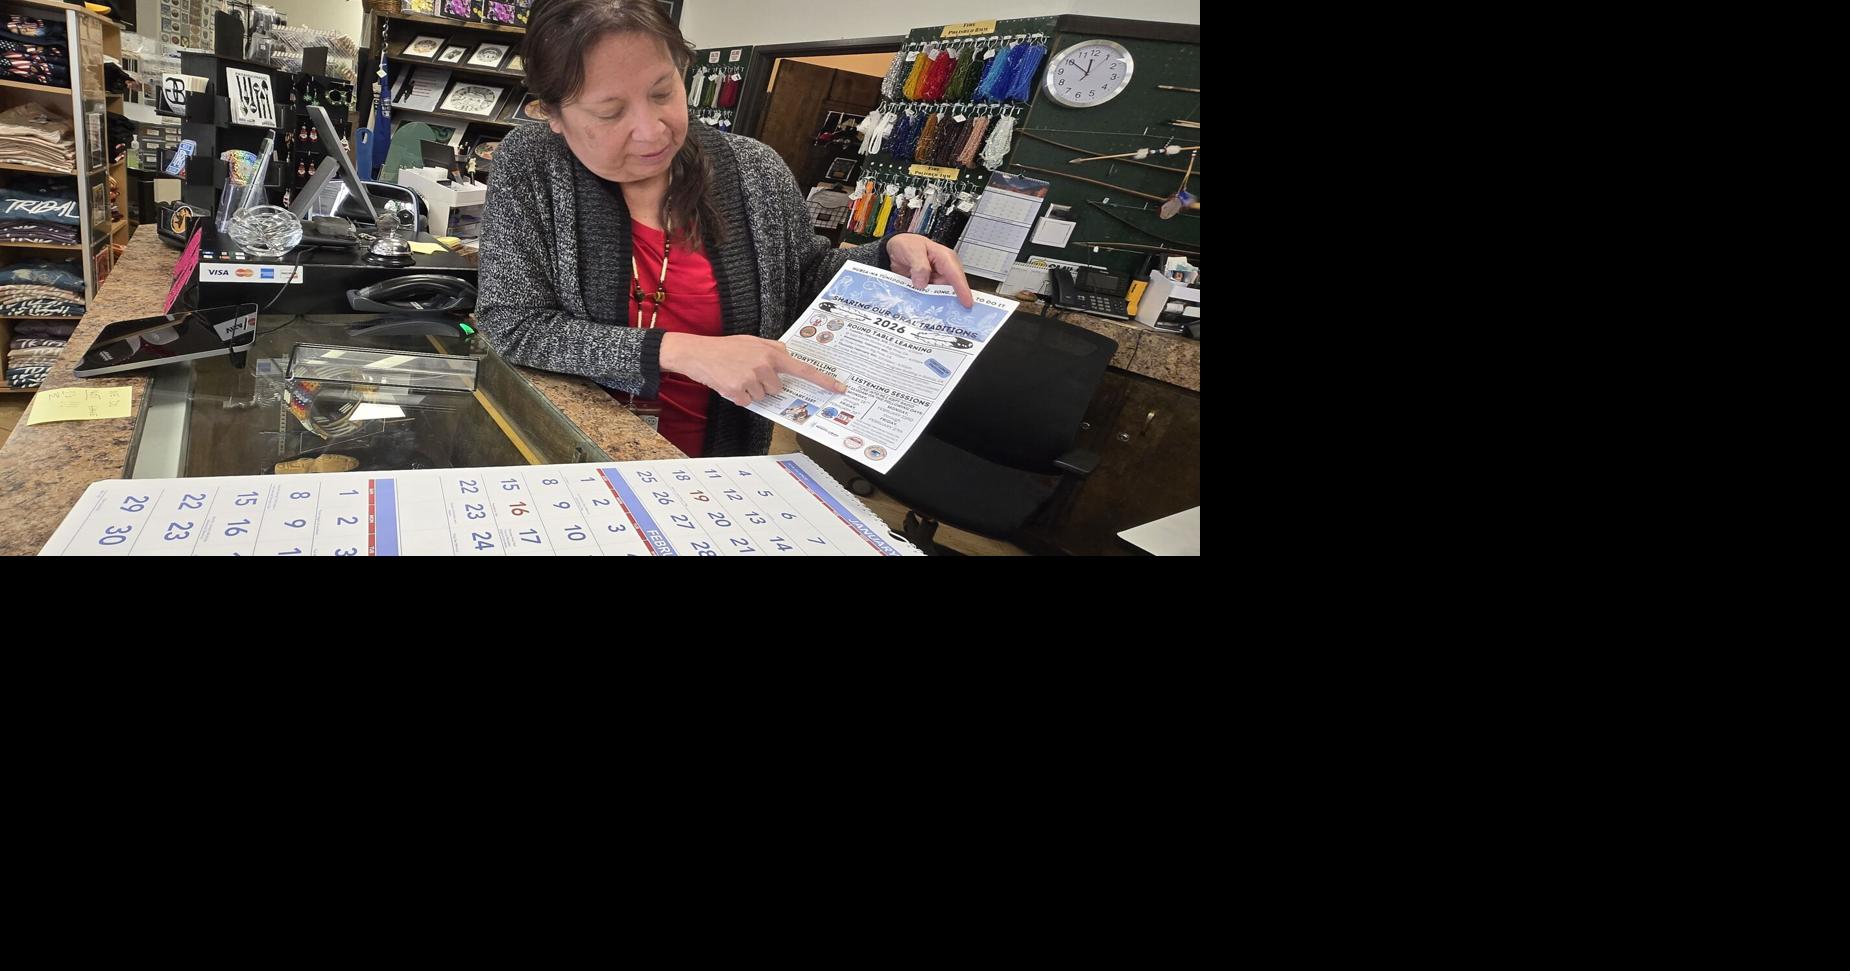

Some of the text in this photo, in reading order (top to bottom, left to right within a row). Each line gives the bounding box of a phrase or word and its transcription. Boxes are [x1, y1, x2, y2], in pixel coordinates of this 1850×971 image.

[5, 198, 80, 218] TRIBAL
[832, 295, 978, 339] SHARING OUR ORAL TRADITIONS
[873, 318, 906, 334] 2026
[847, 322, 932, 354] ROUND TABLE LEARNING
[851, 375, 891, 394] LISTENING
[891, 390, 931, 408] SESSIONS
[120, 495, 149, 513] 29
[164, 493, 207, 541] 22 23
[224, 491, 259, 537] 15 16
[459, 480, 495, 550] 22 23 24
[501, 478, 542, 544] 15 16 17
[592, 498, 610, 506] 2
[608, 524, 626, 533] 3
[637, 470, 658, 484] 25
[652, 491, 674, 505] 26
[670, 514, 696, 530] 27
[672, 469, 756, 554] 18 19 20 21
[704, 468, 793, 552] 11 12 13 14
[98, 525, 132, 546] 30
[278, 491, 311, 556] 8 9 1
[336, 516, 359, 526] 2
[564, 524, 586, 541] 10
[808, 537, 826, 545] 7
